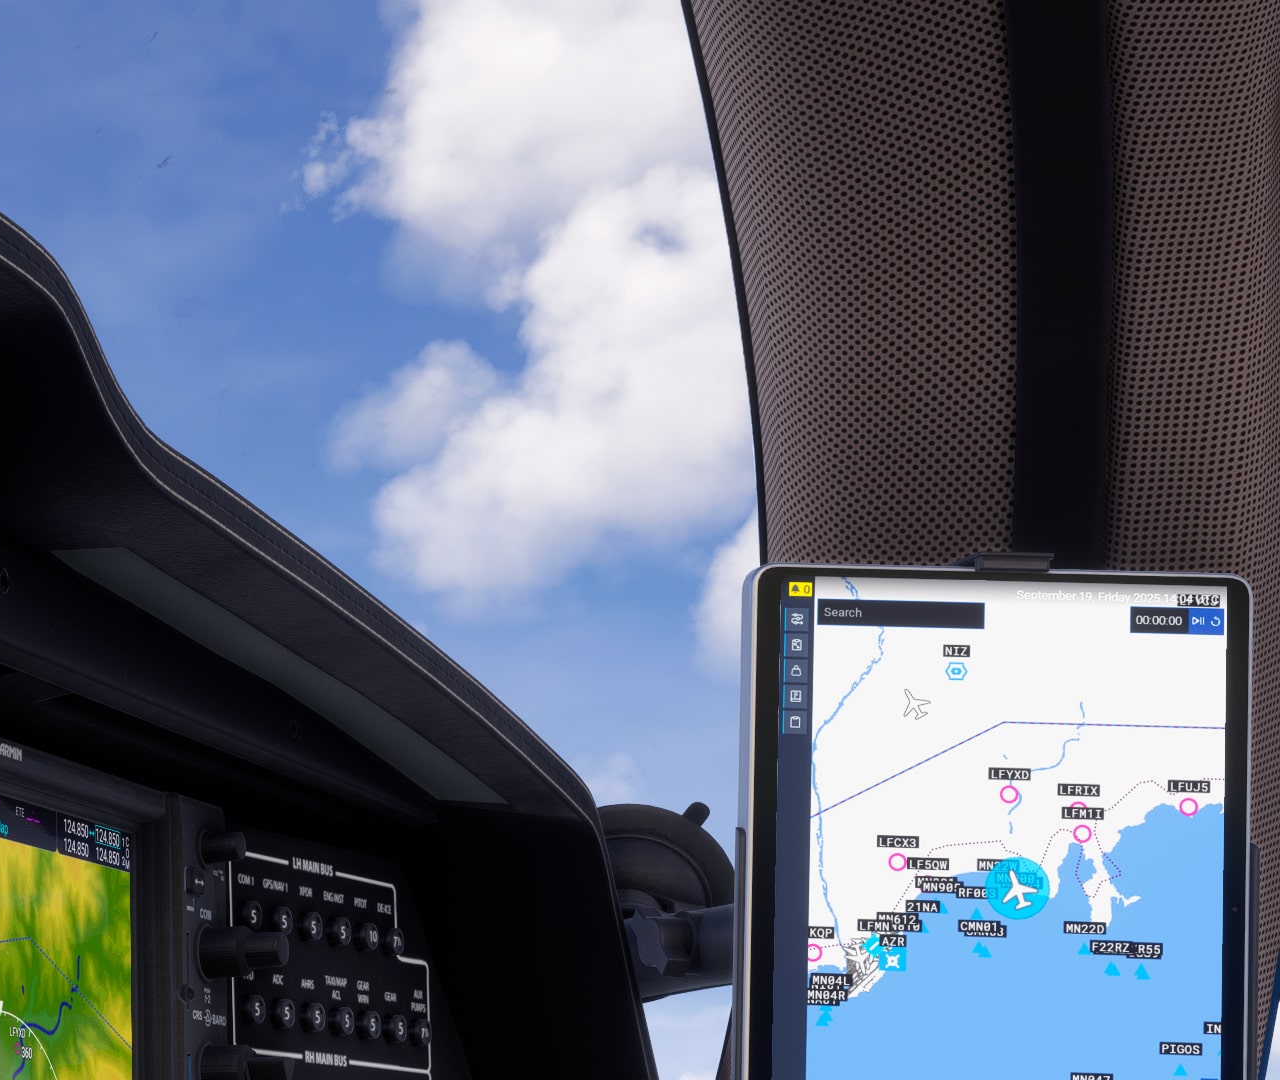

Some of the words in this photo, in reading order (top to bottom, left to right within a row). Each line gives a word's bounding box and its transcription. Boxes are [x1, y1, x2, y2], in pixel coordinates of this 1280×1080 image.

[824, 605, 862, 619] Search
[1136, 615, 1182, 626] 00:00:00
[945, 646, 968, 656] NIZ
[991, 769, 1029, 780] LFYXD
[1060, 785, 1098, 796] LFRIX
[1170, 781, 1208, 793] LFUJ5
[64, 819, 89, 839] 124.850
[96, 826, 119, 847] 124.850
[879, 836, 916, 848] LFCX3
[293, 857, 301, 868] LH
[302, 860, 319, 874] MAIN
[321, 863, 333, 876] BUS
[908, 902, 937, 912] 21NA
[1066, 924, 1104, 934] MN22D
[882, 937, 904, 946] AZR
[1161, 1044, 1201, 1056] PIGOS
